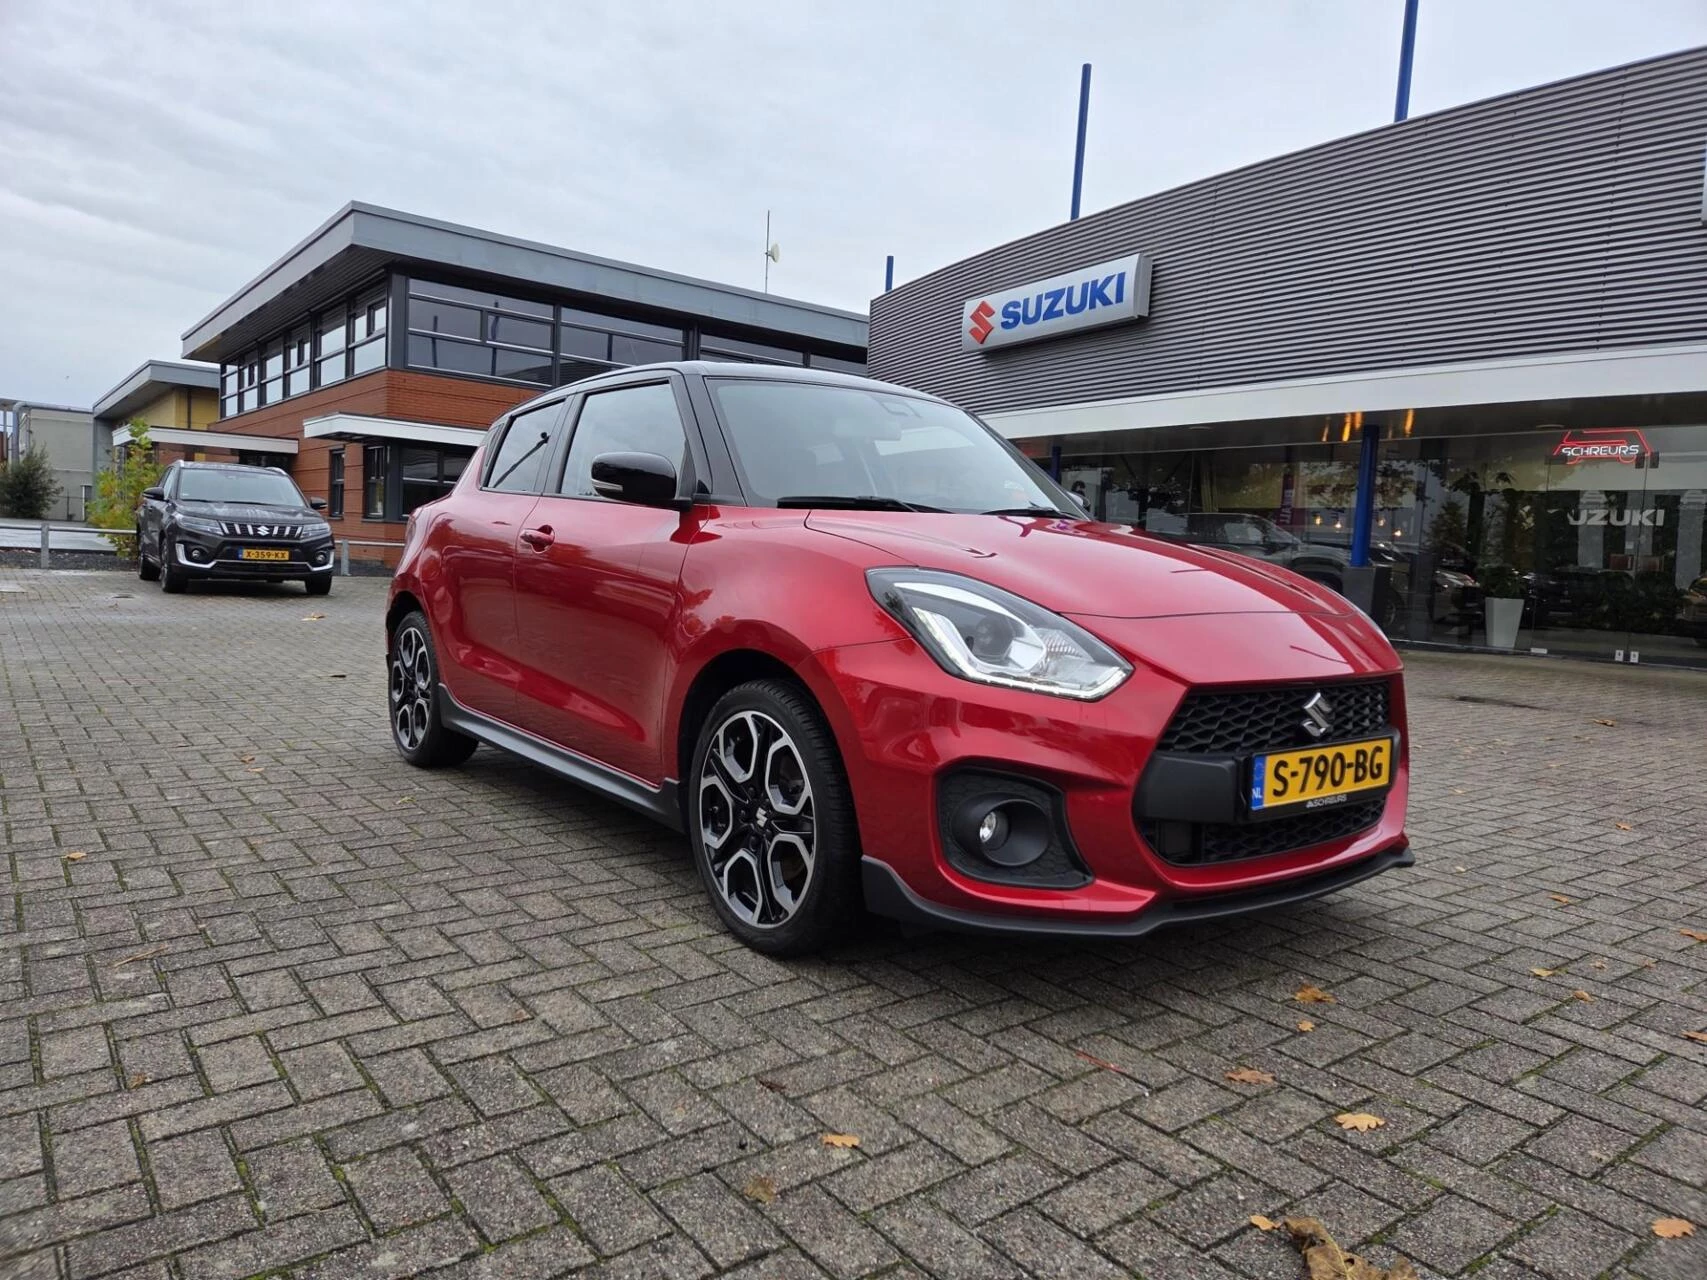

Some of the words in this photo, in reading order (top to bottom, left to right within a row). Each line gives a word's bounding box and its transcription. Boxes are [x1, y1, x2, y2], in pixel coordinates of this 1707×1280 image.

[1000, 271, 1126, 330] SUZUKI
[1561, 444, 1640, 457] SCHREURS
[1547, 508, 1665, 527] UZUKI
[245, 550, 286, 559] X-359-KX
[1272, 745, 1384, 798] S-790-BG
[1251, 787, 1263, 799] NL
